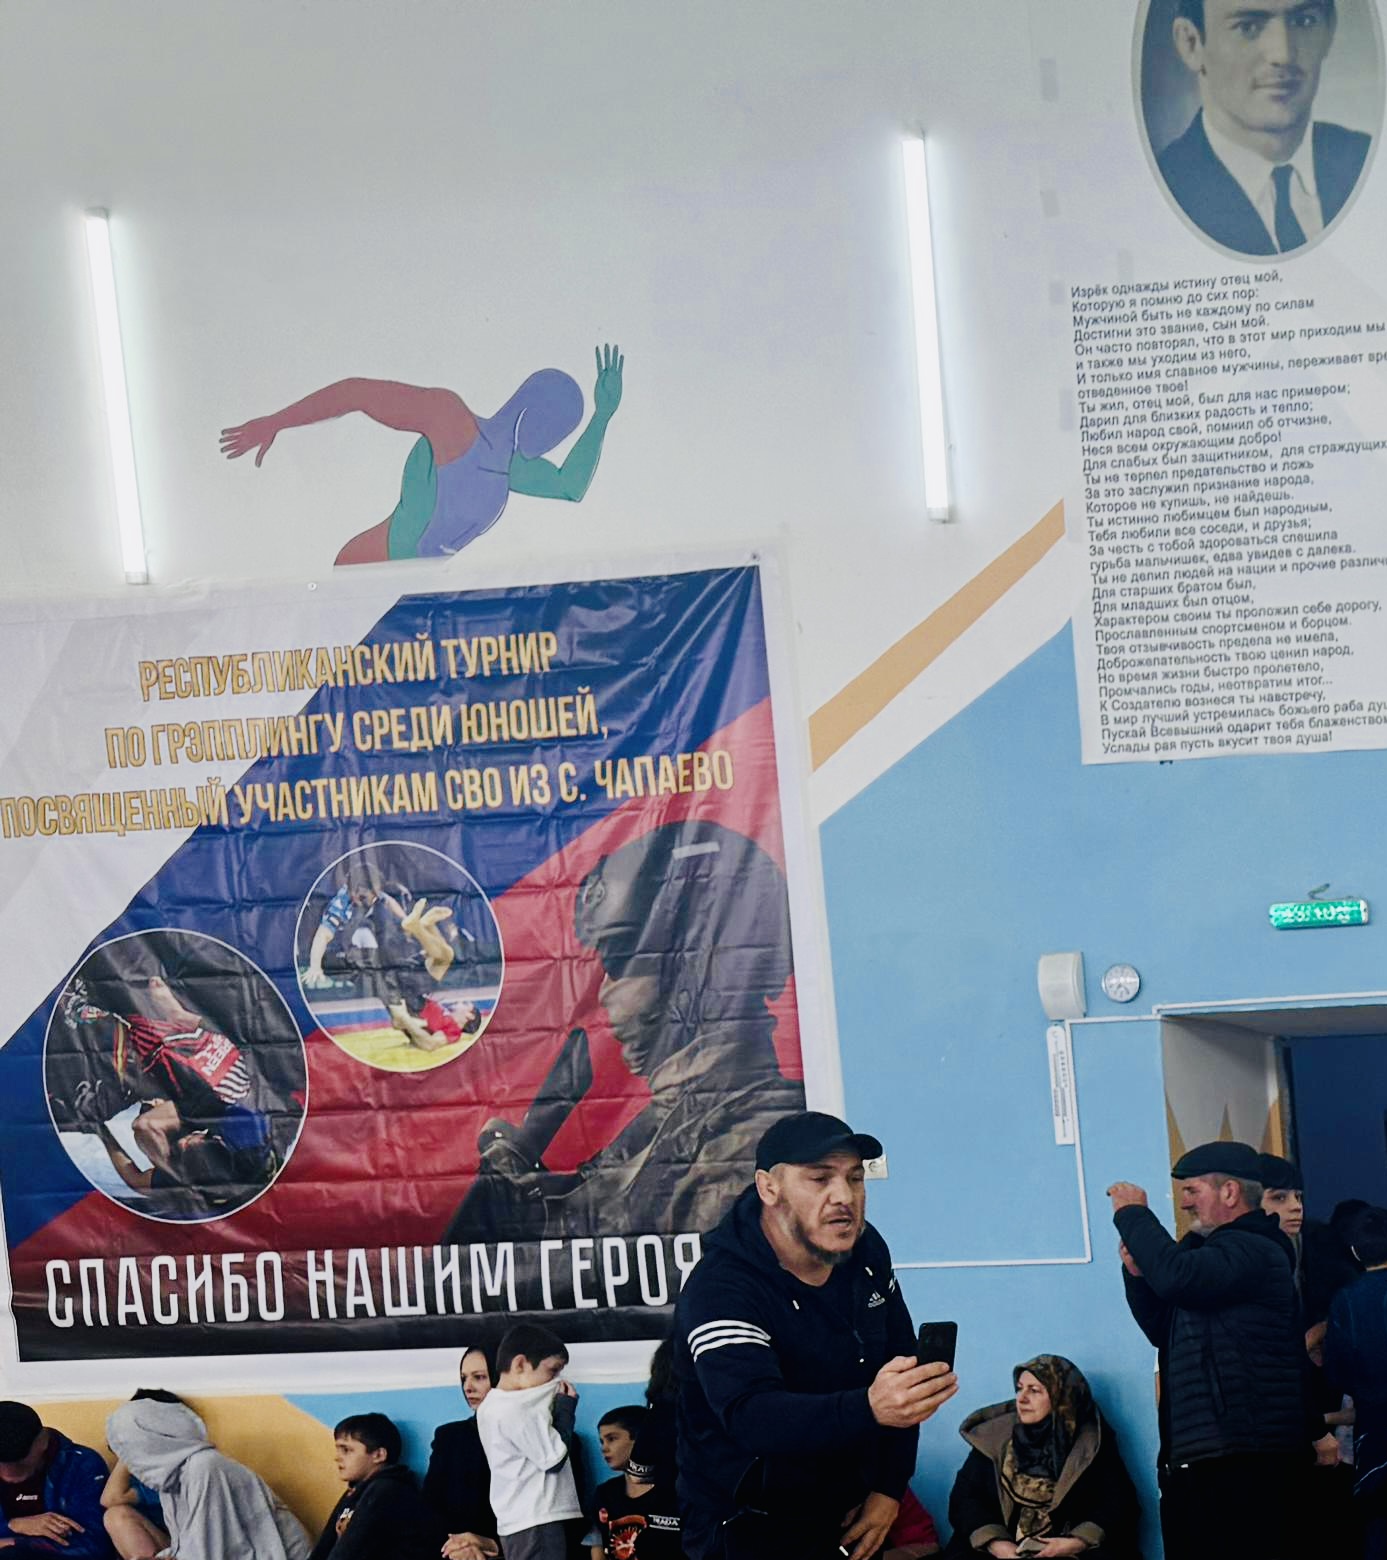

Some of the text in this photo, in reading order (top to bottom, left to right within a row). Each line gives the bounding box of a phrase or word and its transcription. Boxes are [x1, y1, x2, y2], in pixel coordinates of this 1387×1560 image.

[1070, 269, 1283, 300] Изрёк однажды истину отец мой,
[1072, 314, 1138, 329] Мужчиной
[1140, 308, 1173, 321] быть
[1195, 304, 1252, 319] каждому
[1274, 299, 1314, 310] силам
[1072, 315, 1269, 344] Достигни это звание, сын мой.
[1090, 372, 1133, 383] только
[1136, 370, 1161, 380] имя
[1164, 365, 1218, 377] славное
[1221, 360, 1284, 375] мужчины,
[1288, 354, 1363, 370] переживает
[1077, 380, 1188, 401] отведенное твое!
[1080, 431, 1123, 442] Любил
[1126, 427, 1166, 441] народ
[1168, 422, 1202, 435] свой,
[1206, 421, 1254, 432] помнил
[1276, 415, 1332, 427] отчизне,
[1081, 431, 1282, 456] Неся всем окружающим добро!
[1124, 470, 1168, 484] терпел
[1171, 464, 1266, 481] предательство
[1281, 460, 1314, 471] ложь
[1104, 488, 1125, 498] это
[1128, 483, 1189, 498] заслужил
[1193, 479, 1260, 494] признание
[1263, 475, 1314, 489] народа,
[1086, 501, 1137, 516] Которое
[1160, 497, 1210, 511] купишь,
[1233, 489, 1294, 506] найдешь.
[1107, 514, 1159, 526] истинно
[1163, 507, 1230, 525] любимцем
[1233, 505, 1260, 518] был
[1263, 503, 1332, 518] народным,
[1107, 544, 1144, 555] честь
[1157, 538, 1195, 551] тобой
[1199, 535, 1278, 551] здороваться
[1281, 531, 1338, 543] спешила
[1091, 577, 1256, 601] Для старших братом был,
[1092, 595, 1254, 616] Для младших был отцом,
[1094, 614, 1170, 629] Характером
[1173, 611, 1212, 622] своим
[1235, 606, 1299, 620] проложил
[1302, 601, 1332, 614] себе
[1335, 601, 1382, 614] дорогу,
[1094, 627, 1198, 643] Прославленным
[1201, 621, 1286, 637] спортсменом
[1300, 615, 1351, 631] борцом.
[1095, 644, 1126, 655] Твоя
[1128, 640, 1216, 653] отзывчивость
[1218, 637, 1272, 650] предела
[1295, 633, 1338, 644] имела,
[139, 631, 559, 701] РЕСПУБЛИКАНСКИЙ ТУРНИР
[1096, 646, 1354, 671] Доброжелательность твою ценил народ,
[1118, 672, 1158, 684] время
[1161, 669, 1200, 680] жизни
[1203, 664, 1250, 680] быстро
[1252, 662, 1324, 676] пролетело,
[1098, 676, 1332, 700] Промчались годы, неотвратим итог...
[1110, 699, 1181, 713] Создателю
[1184, 696, 1235, 707] вознеся
[1258, 691, 1326, 705] навстречу,
[105, 686, 609, 768] ПО ГРЭППЛИНГУ СРЕДИ ЮНОШЕЙ,
[1101, 729, 1146, 742] Пускай
[1150, 725, 1224, 737] Всевышний
[1226, 723, 1271, 735] одарит
[1276, 718, 1304, 730] тебя
[0, 750, 734, 838] ПОСВЯЩЕННЫЙ УЧАСТНИКАМ СВО ИЗ С. ЧАПАЕВО
[46, 1233, 703, 1328] СПАСИБО НАШИМ ГЕРОЯ
